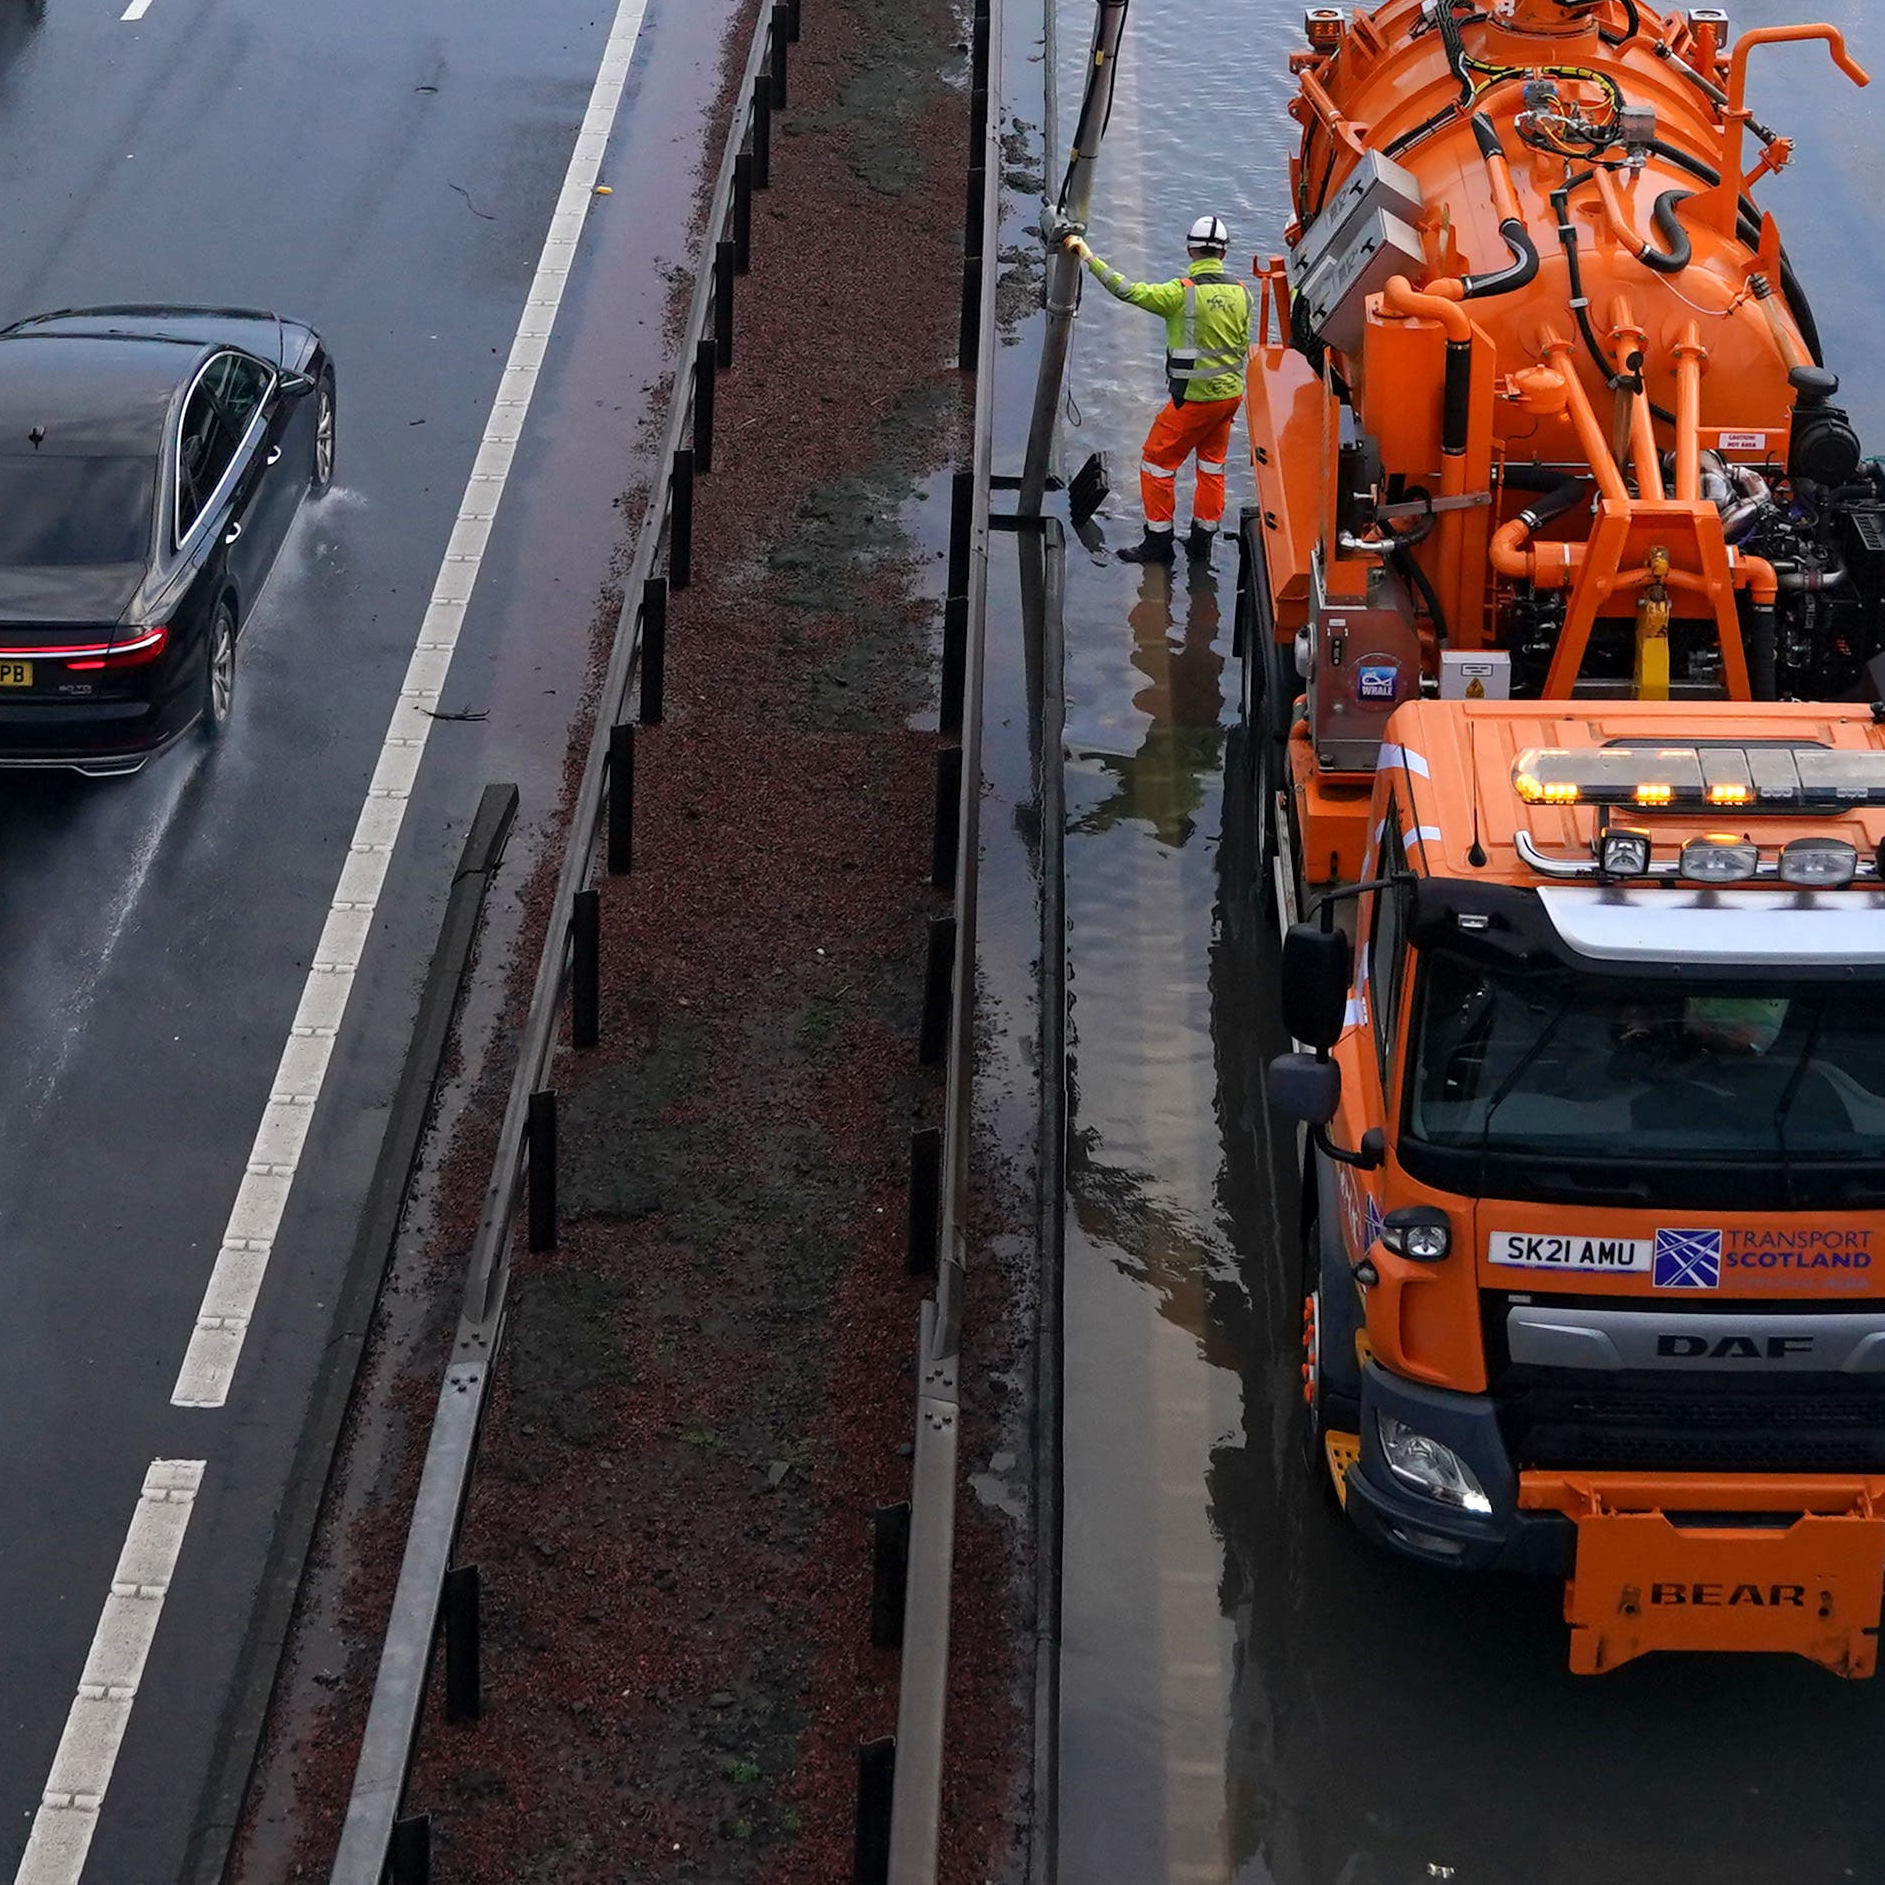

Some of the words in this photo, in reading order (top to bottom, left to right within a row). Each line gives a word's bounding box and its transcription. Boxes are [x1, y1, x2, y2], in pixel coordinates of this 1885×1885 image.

[1361, 686, 1392, 696] WHALE
[1728, 1230, 1873, 1249] TRANSPORT
[1507, 1236, 1571, 1262] SK21
[1580, 1241, 1635, 1266] AMU
[1726, 1252, 1871, 1268] SCOTLAND
[1657, 1334, 1813, 1359] DAF
[1650, 1583, 1805, 1607] BEAR
